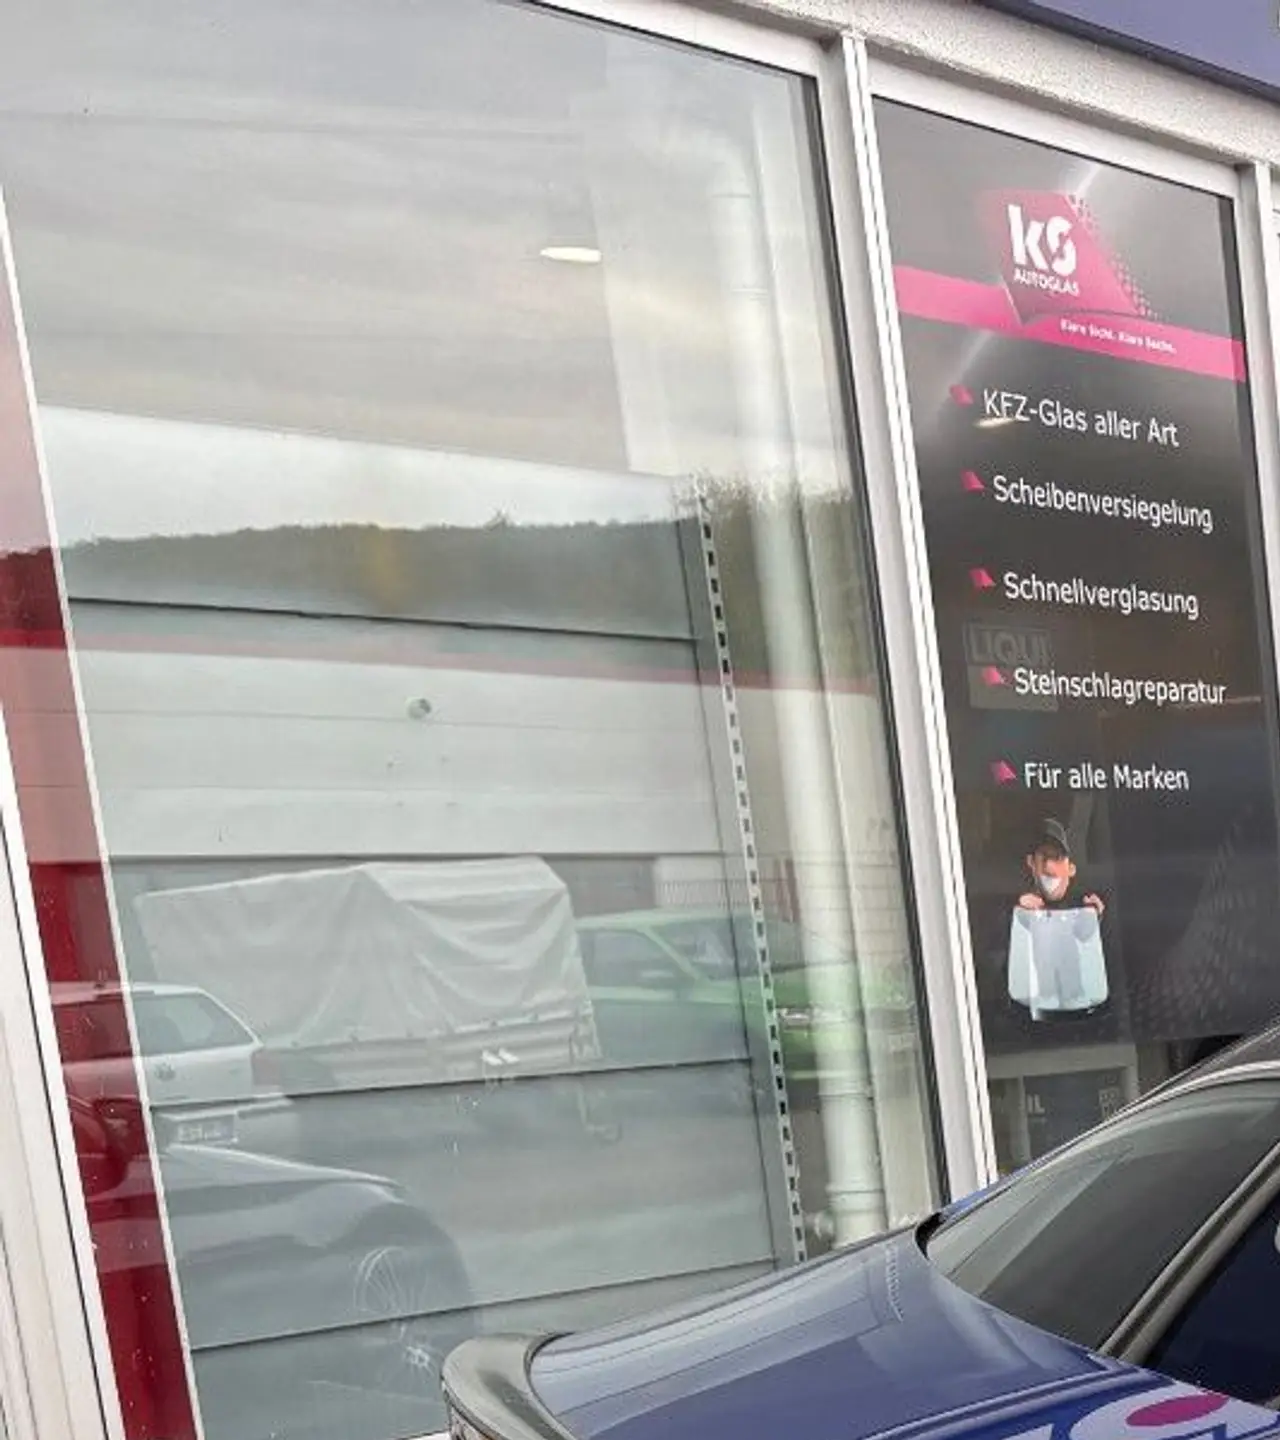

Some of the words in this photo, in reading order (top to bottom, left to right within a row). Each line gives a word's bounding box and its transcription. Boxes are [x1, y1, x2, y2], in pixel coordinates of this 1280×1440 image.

[1013, 267, 1080, 297] AUTOGLAS
[983, 388, 1087, 432] KFZ-Glas
[1095, 410, 1142, 442] aller
[1147, 417, 1180, 448] Art
[993, 474, 1214, 534] Scheibenversiegelung
[1004, 571, 1200, 621] Schnellverglasung
[1013, 667, 1228, 706] Steinschlagreparatur
[1024, 762, 1062, 790] Für
[1069, 763, 1106, 789] alle
[1114, 764, 1190, 791] Marken
